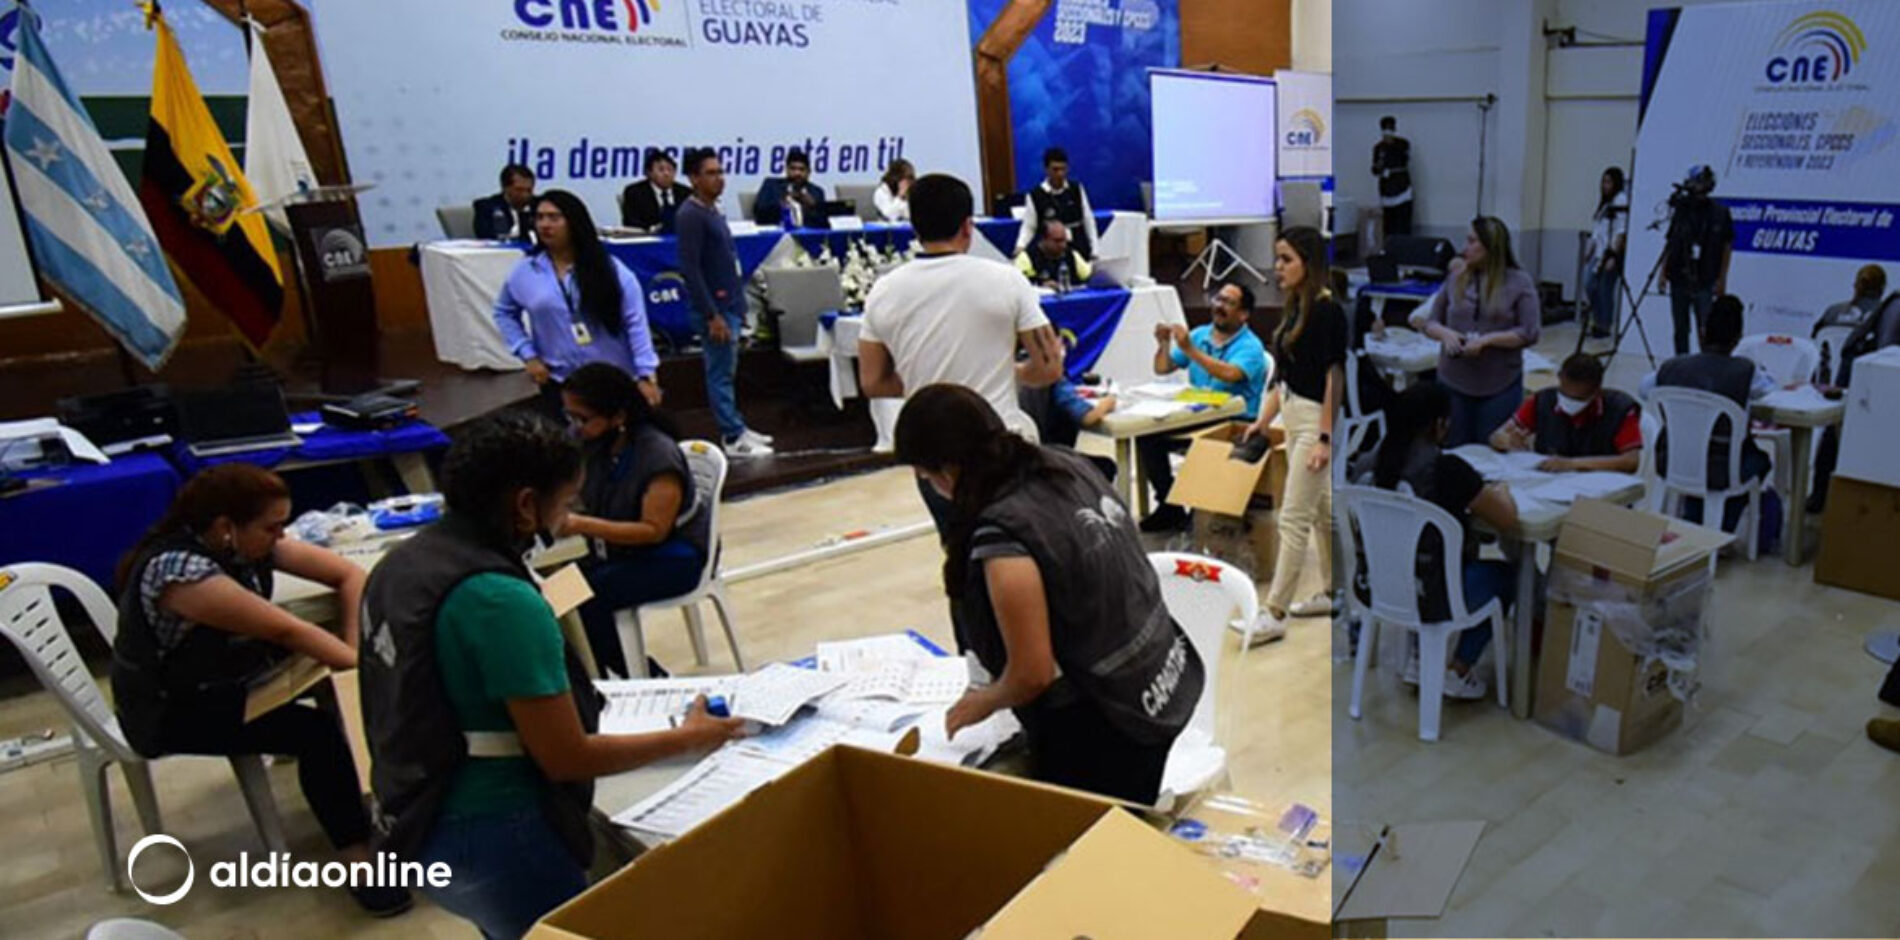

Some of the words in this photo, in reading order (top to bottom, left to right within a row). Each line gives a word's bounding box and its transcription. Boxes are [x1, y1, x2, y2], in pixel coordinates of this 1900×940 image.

[700, 0, 799, 20] ELECTORAL
[802, 4, 823, 21] DE
[501, 29, 558, 42] CONSEJO
[561, 33, 621, 44] NACIONAL
[702, 18, 809, 48] GUAYAS
[770, 136, 830, 174] etá
[838, 144, 869, 173] en
[1752, 228, 1819, 251] GUAYAS
